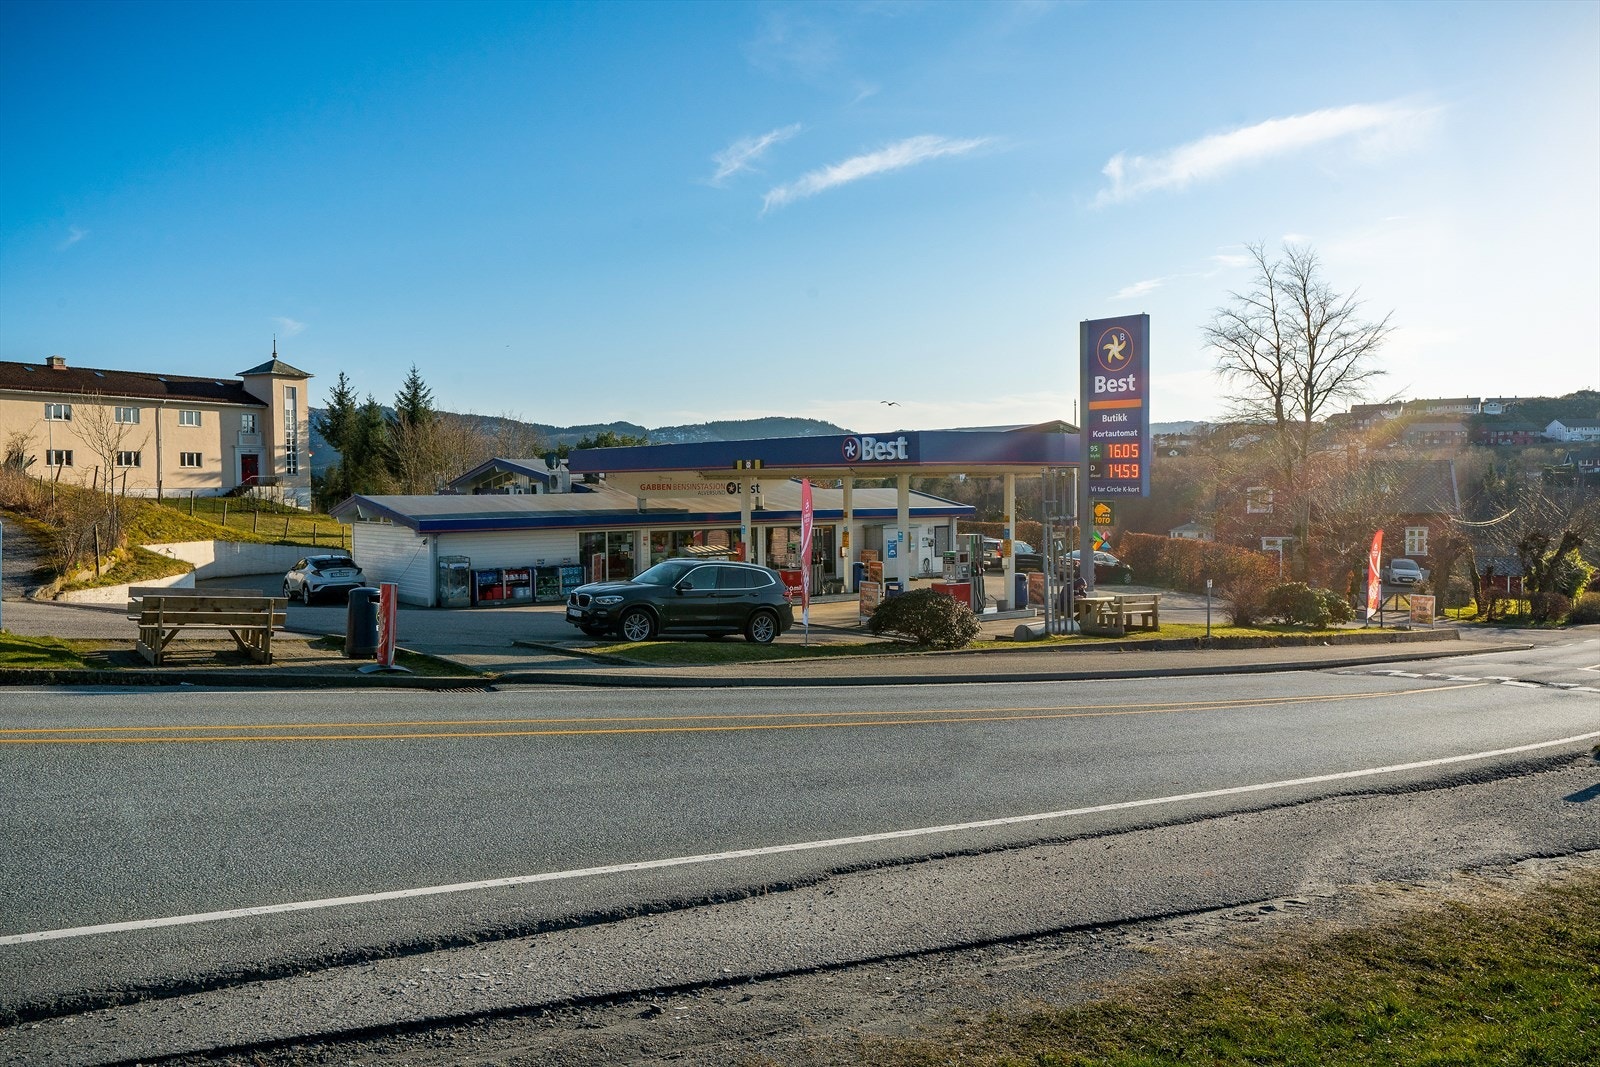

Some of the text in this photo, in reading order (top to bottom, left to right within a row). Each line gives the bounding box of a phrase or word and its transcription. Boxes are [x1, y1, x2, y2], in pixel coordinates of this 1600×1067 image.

[1095, 373, 1136, 394] Best
[1102, 413, 1128, 423] Butikk
[1092, 429, 1138, 438] Kortautomat
[861, 436, 908, 461] Best
[1108, 443, 1139, 458] 16.05
[1108, 463, 1139, 478] 14.59
[640, 482, 726, 491] GABBEN BENSINSTASJON
[737, 482, 760, 494] Bst
[1094, 516, 1111, 524] TOTO
